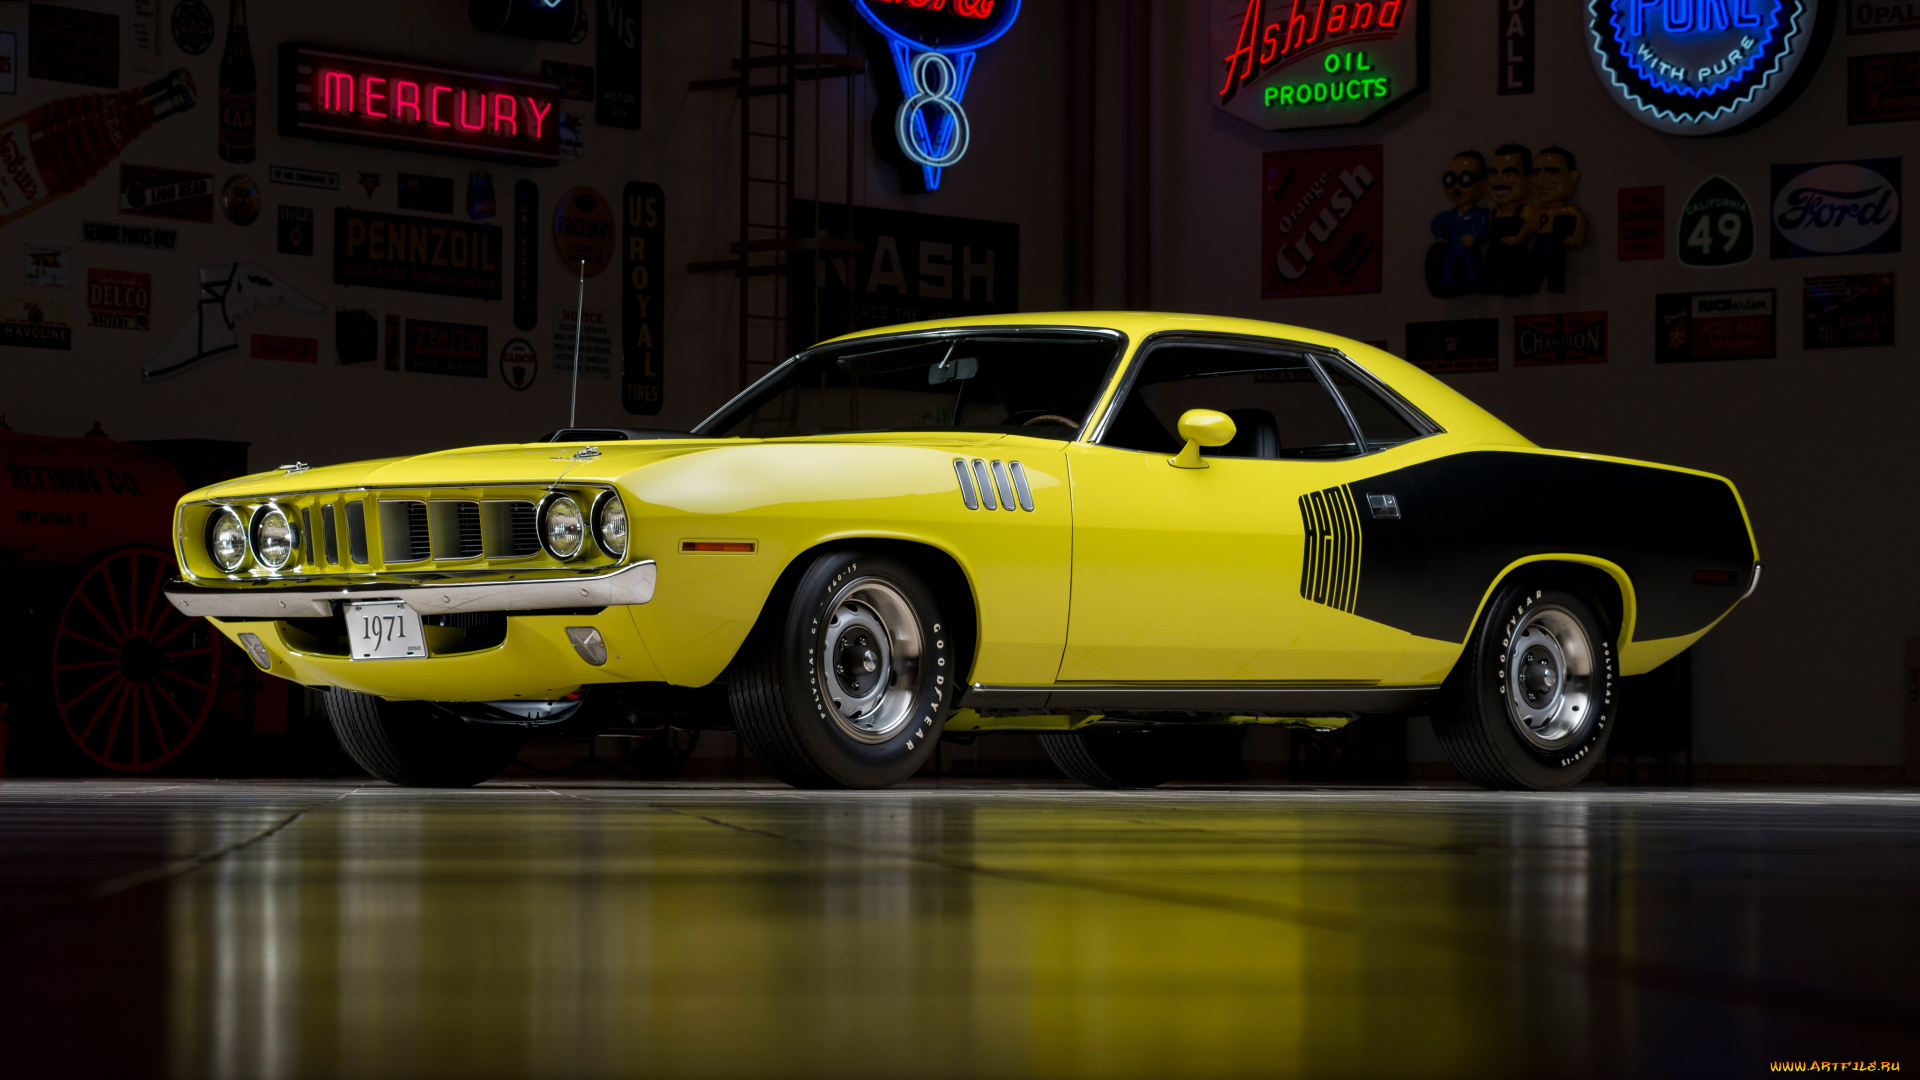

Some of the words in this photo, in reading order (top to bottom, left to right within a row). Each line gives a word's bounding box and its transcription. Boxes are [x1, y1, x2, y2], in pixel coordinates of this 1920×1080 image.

[1324, 51, 1372, 74] OIL
[1638, 43, 1686, 81] WITH
[1698, 35, 1756, 82] PURE
[320, 70, 552, 141] MERCURY
[604, 91, 635, 105] MOTOR
[1264, 77, 1389, 107] PRODUCTS
[222, 106, 253, 129] AAA
[612, 104, 628, 117] OIL
[1685, 198, 1748, 216] CALIFORNIA
[1778, 185, 1893, 229] Ford
[122, 226, 153, 246] PARTS
[1276, 164, 1375, 282] Crush
[1686, 212, 1742, 255] 49
[346, 216, 497, 273] PENNZOIL
[377, 265, 408, 282] PURE
[412, 270, 497, 291] PENNSYLVANIA
[815, 228, 996, 304] NASH
[90, 282, 148, 310] DELCO
[629, 235, 658, 378] ROYAL
[894, 306, 920, 322] THE
[1840, 313, 1887, 328] DOUBLE
[5, 325, 67, 341] HAVOLINE
[412, 324, 483, 358] ZENITH
[1519, 324, 1600, 355] CHAMPION
[1847, 328, 1880, 341] COLA
[627, 383, 659, 403] TIRES
[5, 461, 103, 494] REFINING
[106, 468, 144, 497] CO.
[363, 615, 406, 652] 1971
[1498, 589, 1542, 695] GOODYEAR
[905, 622, 946, 751] GOODYEAR
